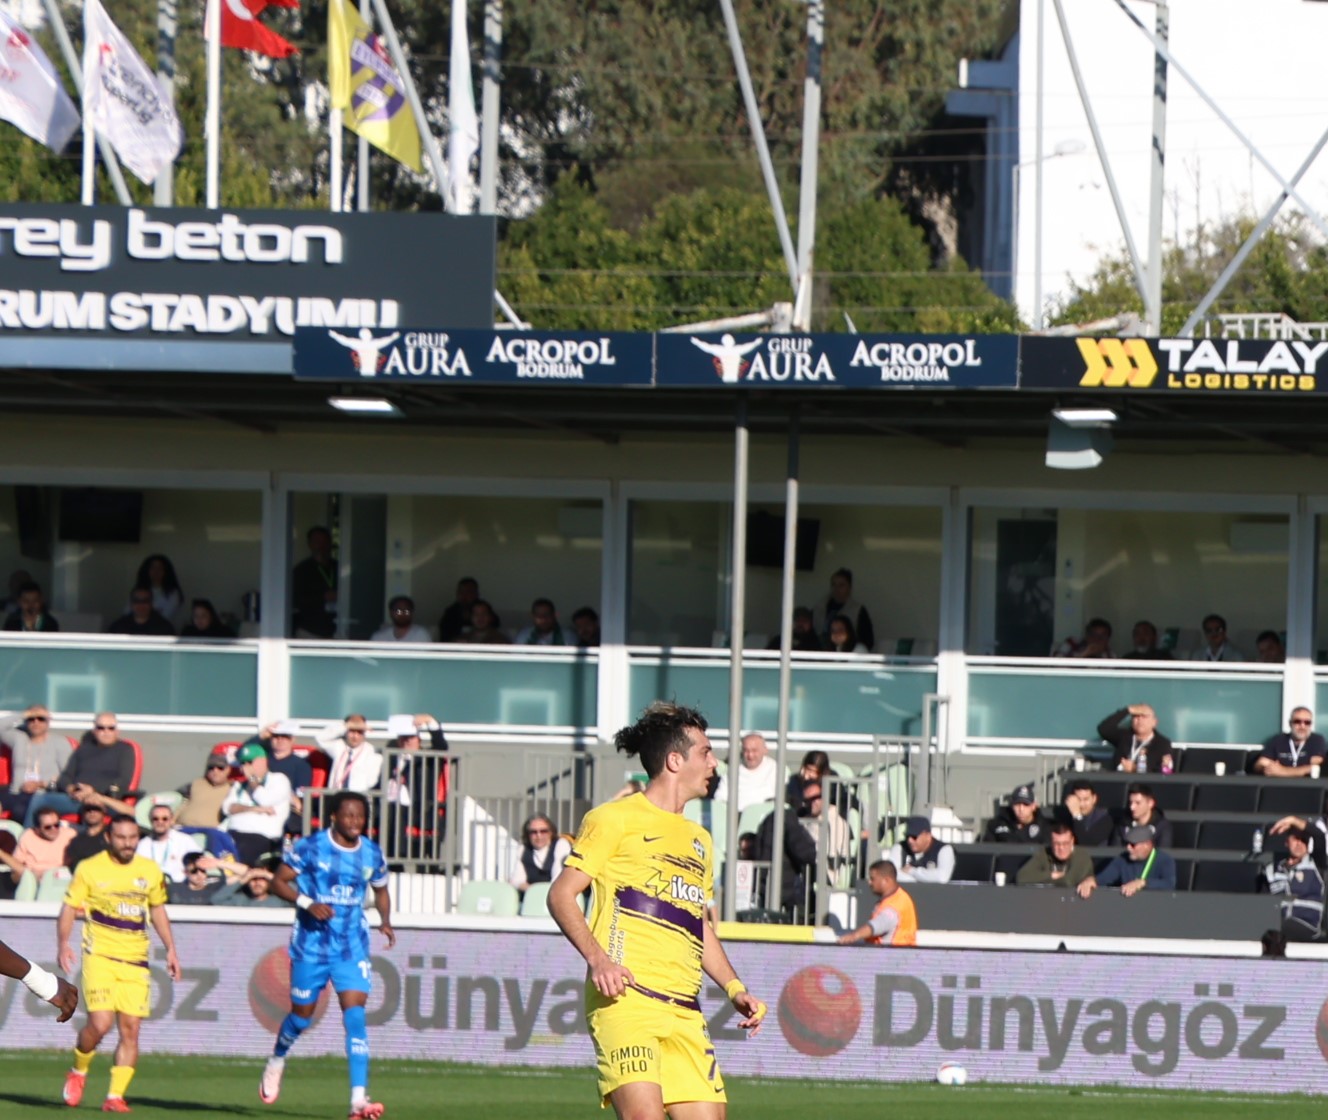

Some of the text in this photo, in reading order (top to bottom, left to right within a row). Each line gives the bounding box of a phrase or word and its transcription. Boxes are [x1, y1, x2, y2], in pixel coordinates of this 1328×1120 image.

[126, 208, 344, 264] beton
[109, 290, 399, 335] STADYUMU
[404, 332, 449, 348] GRUP
[486, 336, 616, 365] ACROPOL
[767, 337, 813, 353] GRUP
[850, 338, 982, 367] ACROPOL
[384, 347, 472, 376] AURA
[516, 362, 584, 379] BODRUM
[746, 352, 836, 381] AURA
[880, 364, 950, 382] BODRUM
[1167, 373, 1316, 390] LOGISTICS
[873, 973, 1288, 1077] Dünyagöz
